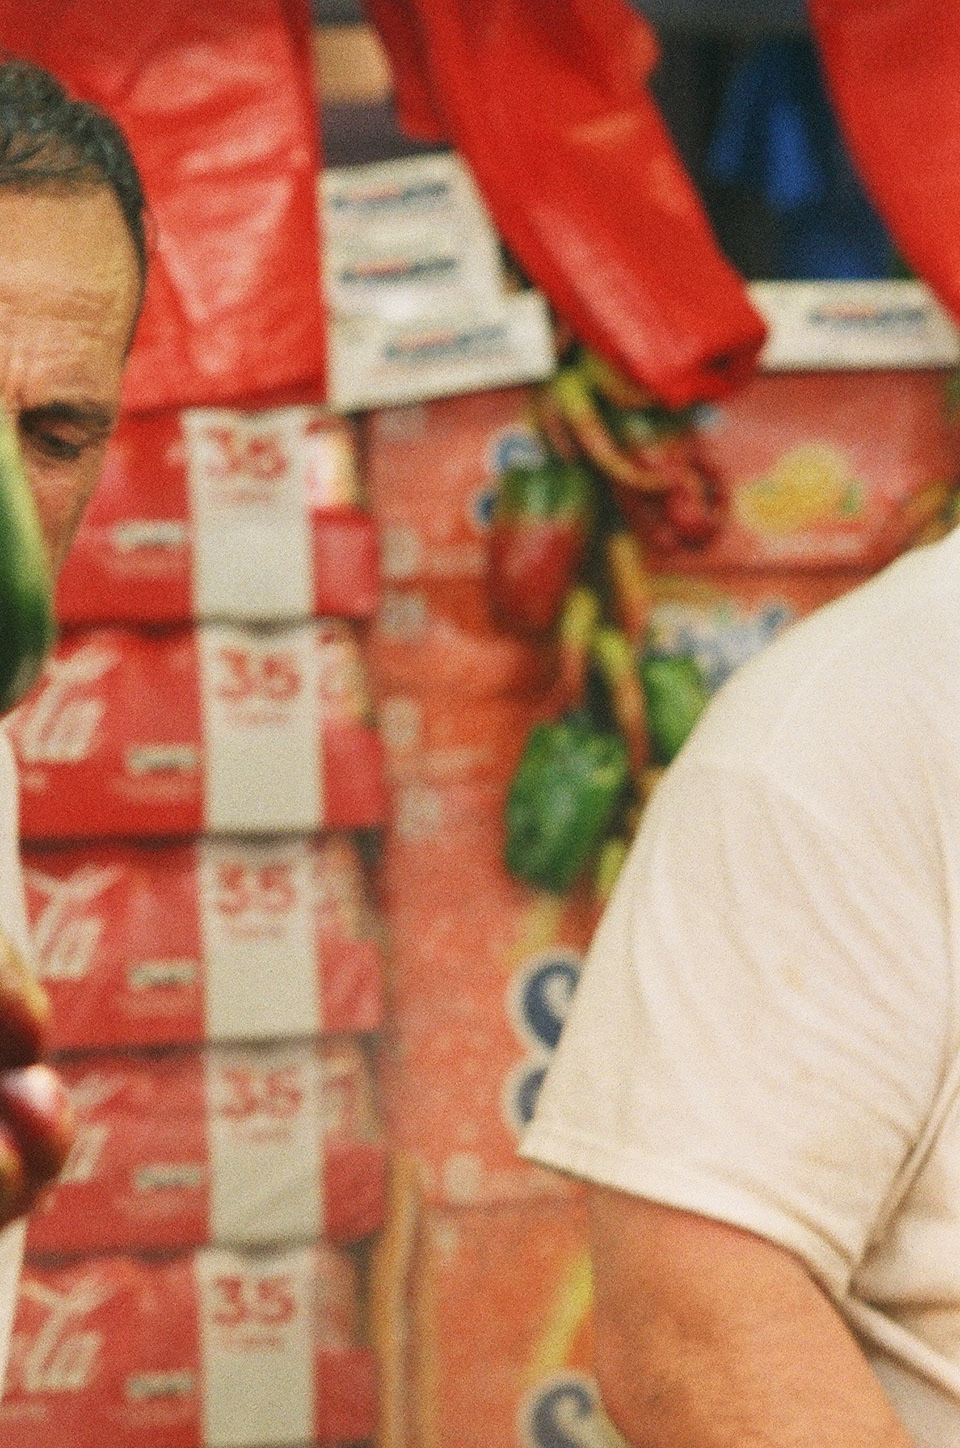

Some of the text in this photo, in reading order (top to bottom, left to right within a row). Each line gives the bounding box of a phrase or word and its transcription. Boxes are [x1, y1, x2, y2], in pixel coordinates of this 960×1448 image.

[217, 648, 302, 702] 35
[216, 861, 297, 917] 35
[220, 1068, 302, 1121] 35
[212, 1271, 295, 1328] 35
